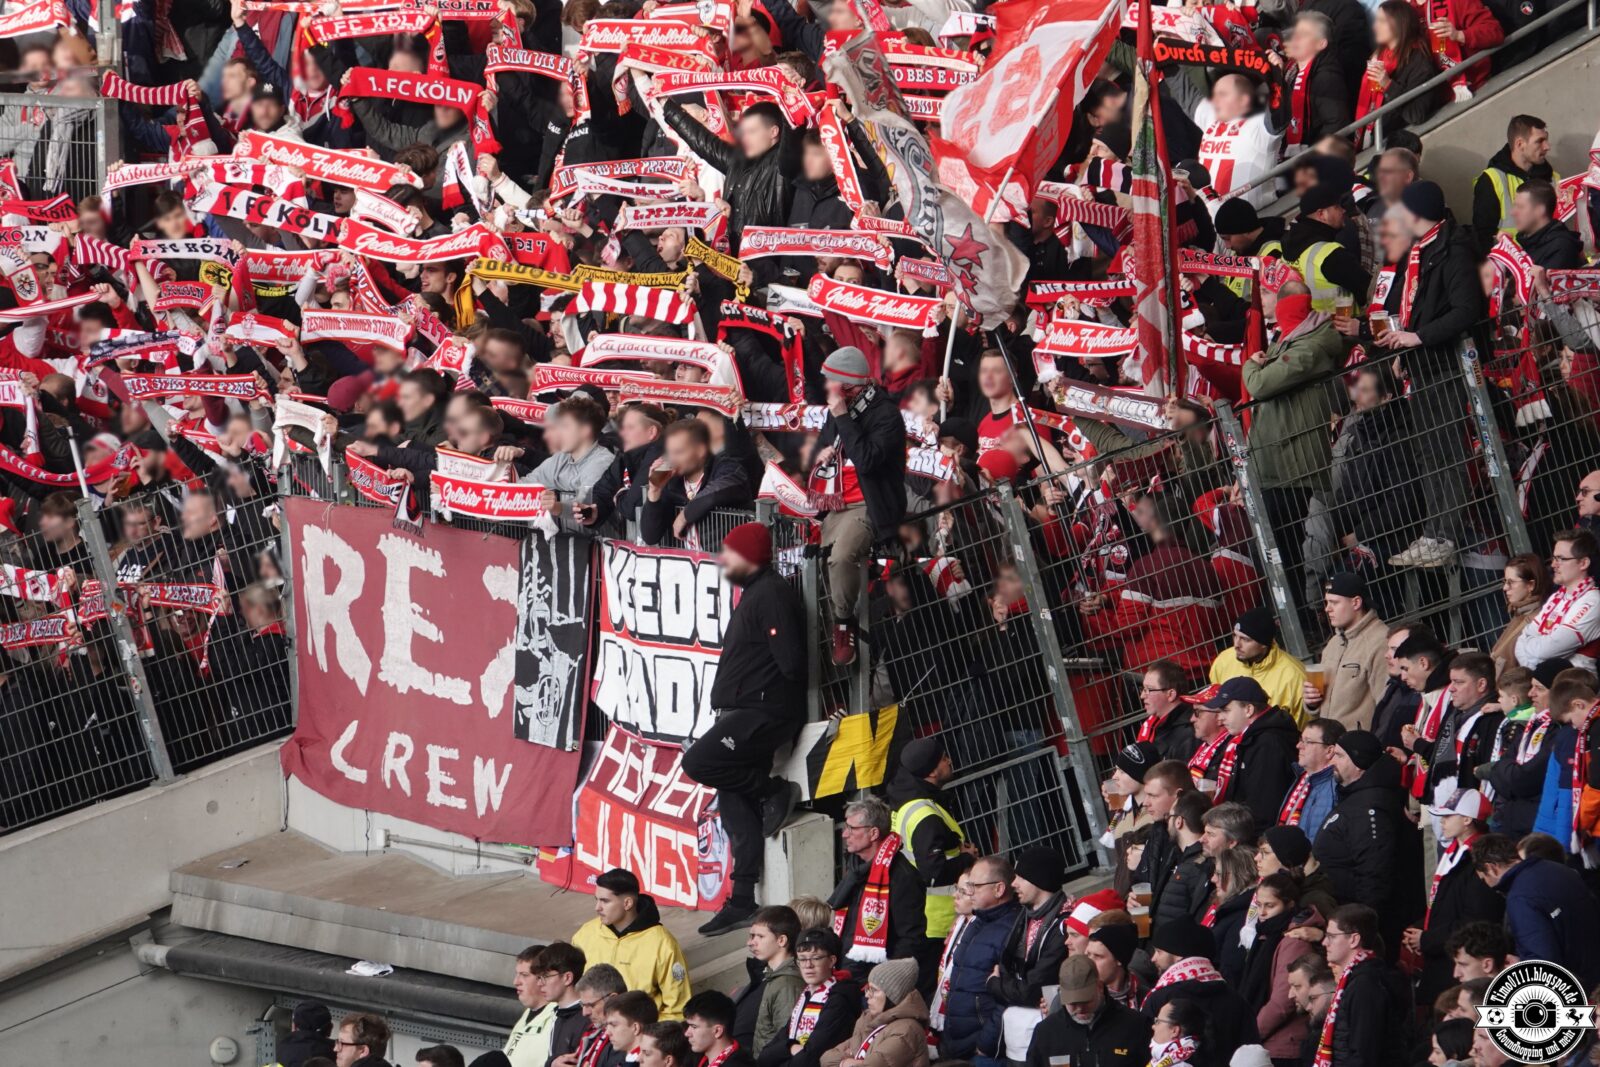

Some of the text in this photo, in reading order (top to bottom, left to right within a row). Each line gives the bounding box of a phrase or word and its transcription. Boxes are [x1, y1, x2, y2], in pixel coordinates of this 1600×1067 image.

[334, 20, 363, 34] FC
[372, 15, 430, 31] KÖLN
[1155, 42, 1271, 75] Durch et Füer
[368, 76, 473, 105] 1. FC KÖLN
[906, 69, 934, 83] BES
[937, 70, 947, 84] E
[223, 191, 340, 237] 1. FC KÖLN
[157, 243, 180, 253] FC
[184, 239, 241, 267] KÖLN
[330, 719, 513, 819] CREW
[576, 800, 699, 908] JUNGS
